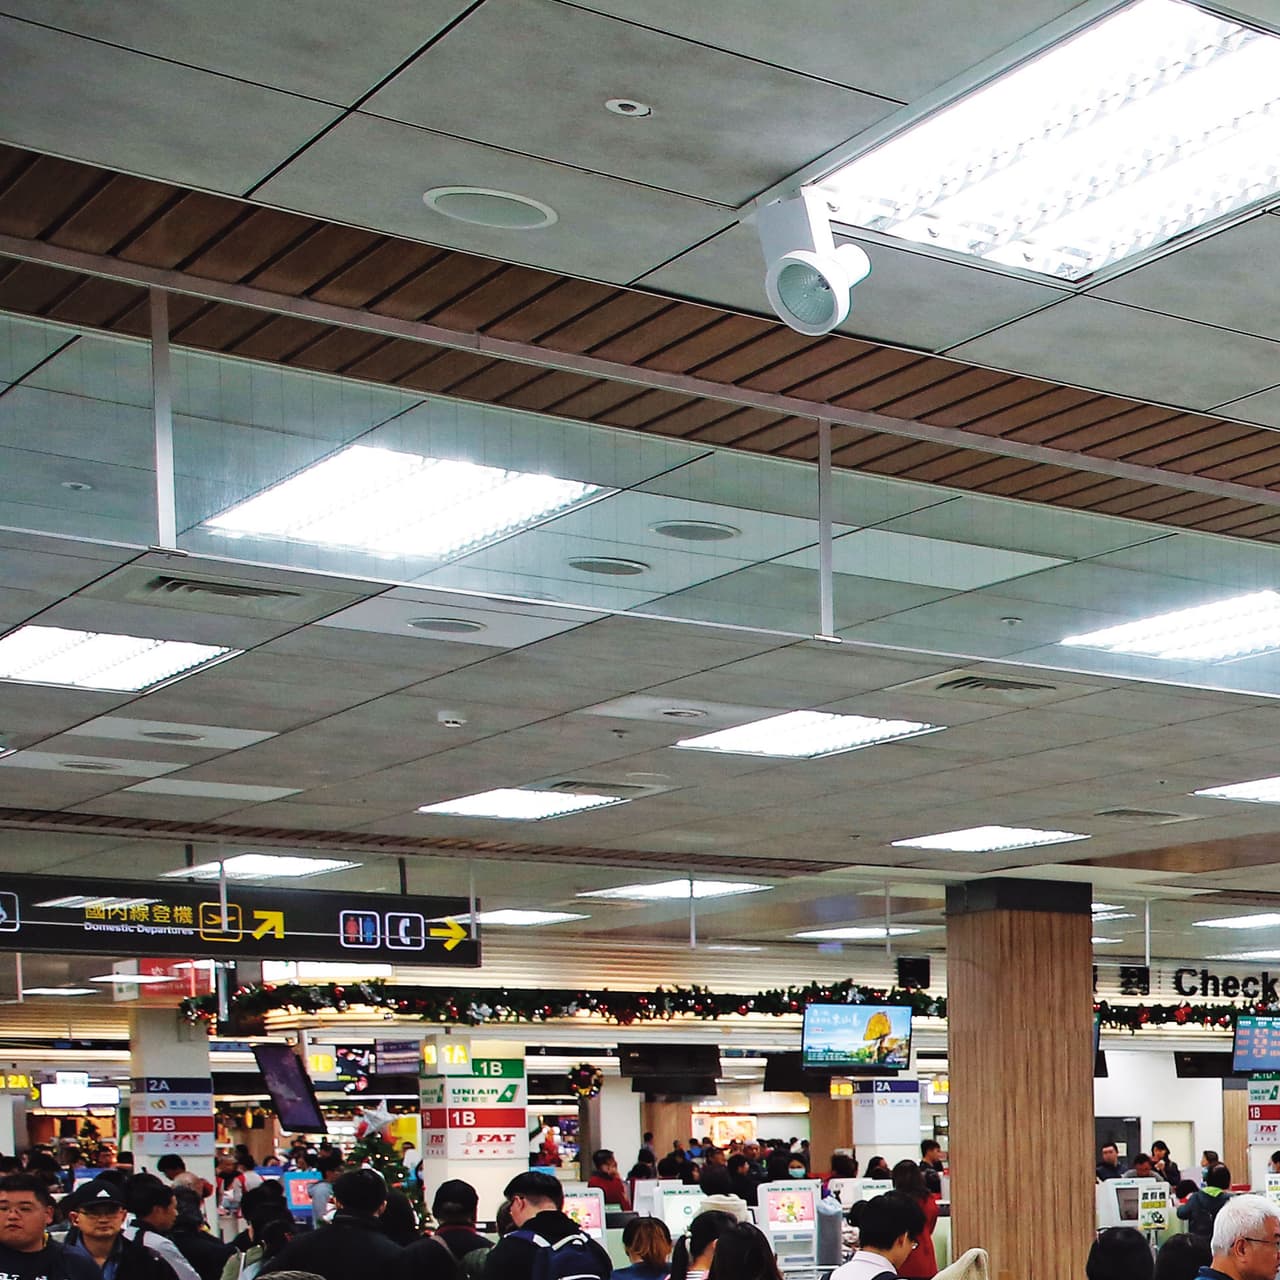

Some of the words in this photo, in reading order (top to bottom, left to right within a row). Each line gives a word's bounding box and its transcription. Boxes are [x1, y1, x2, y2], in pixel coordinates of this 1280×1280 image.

[84, 922, 134, 932] Domestic
[137, 924, 194, 935] Departures
[149, 1080, 170, 1092] 2A
[876, 1081, 891, 1092] 2A
[1249, 1106, 1261, 1118] 1B
[452, 1110, 476, 1127] 1B
[152, 1119, 176, 1131] 2B
[475, 1134, 516, 1143] FAT
